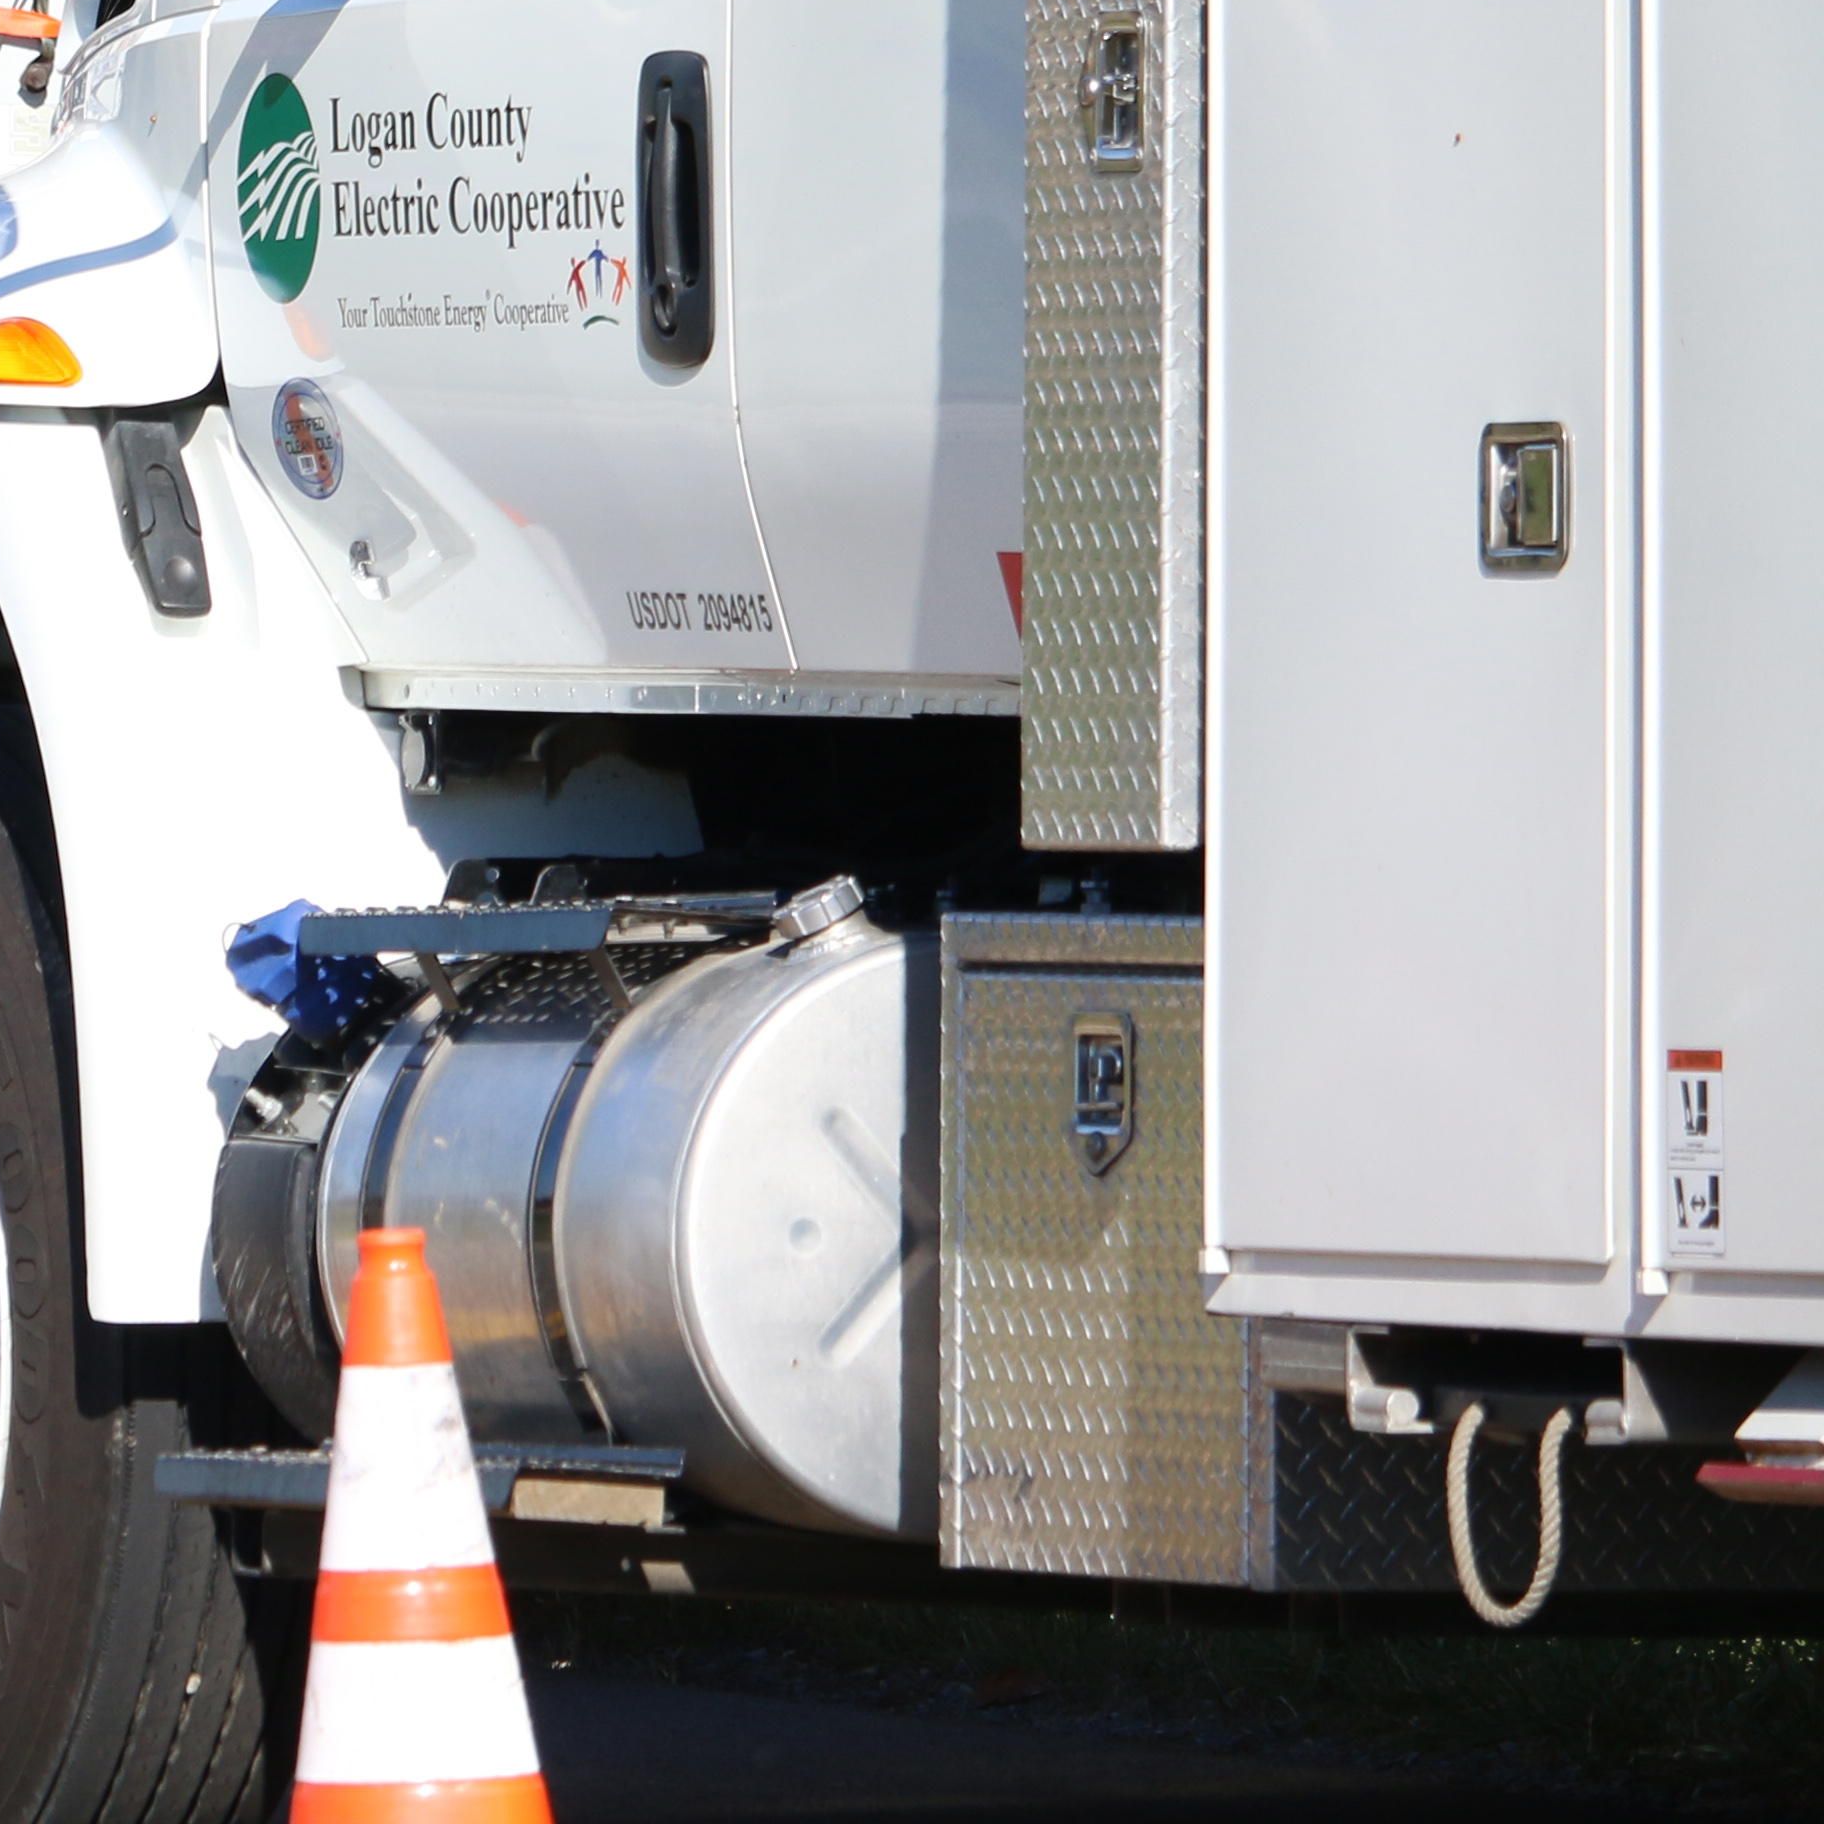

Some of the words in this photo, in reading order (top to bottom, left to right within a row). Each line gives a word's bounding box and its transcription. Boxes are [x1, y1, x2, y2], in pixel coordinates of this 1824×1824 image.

[329, 96, 417, 169] Logan
[425, 91, 532, 164] County
[331, 178, 440, 238] Electric
[448, 172, 625, 250] Cooperative
[337, 297, 368, 331] Your
[493, 294, 570, 331] Cooperative
[626, 591, 692, 631] USDOT
[697, 593, 773, 633] 2094815
